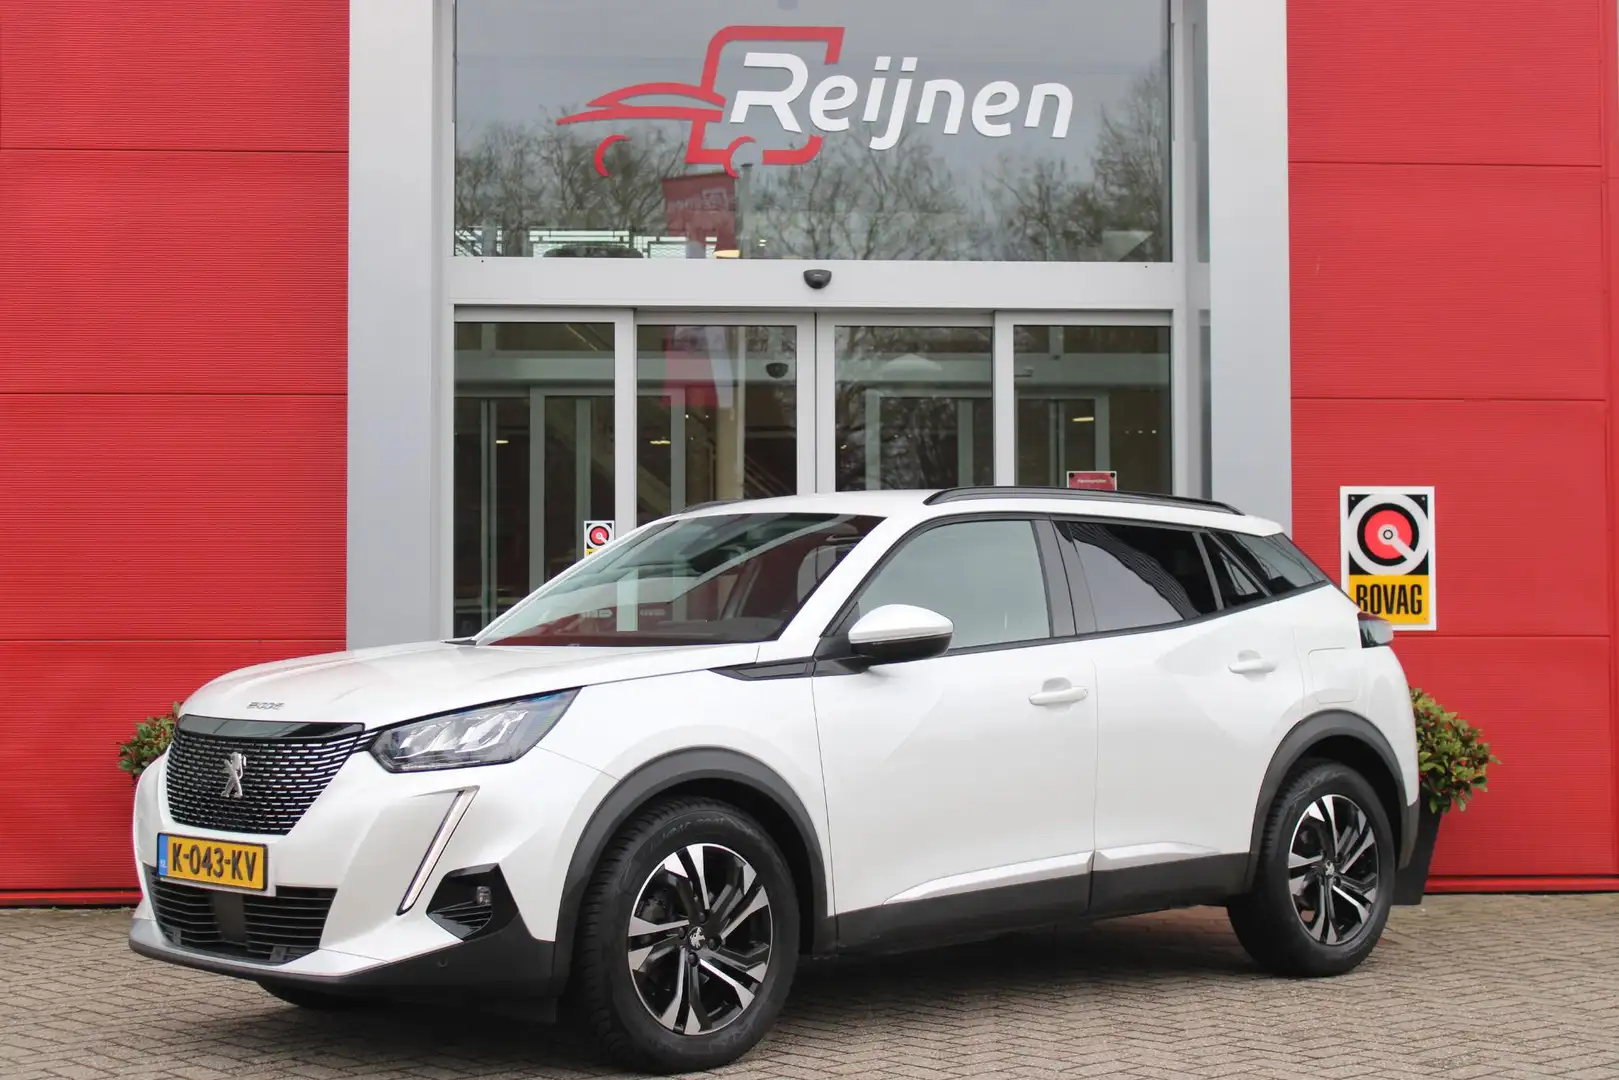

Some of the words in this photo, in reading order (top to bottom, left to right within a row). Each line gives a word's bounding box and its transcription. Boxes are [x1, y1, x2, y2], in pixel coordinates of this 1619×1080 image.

[729, 52, 1074, 151] Reijnen
[1356, 584, 1422, 615] BOVAG
[172, 843, 257, 882] K-043-KV
